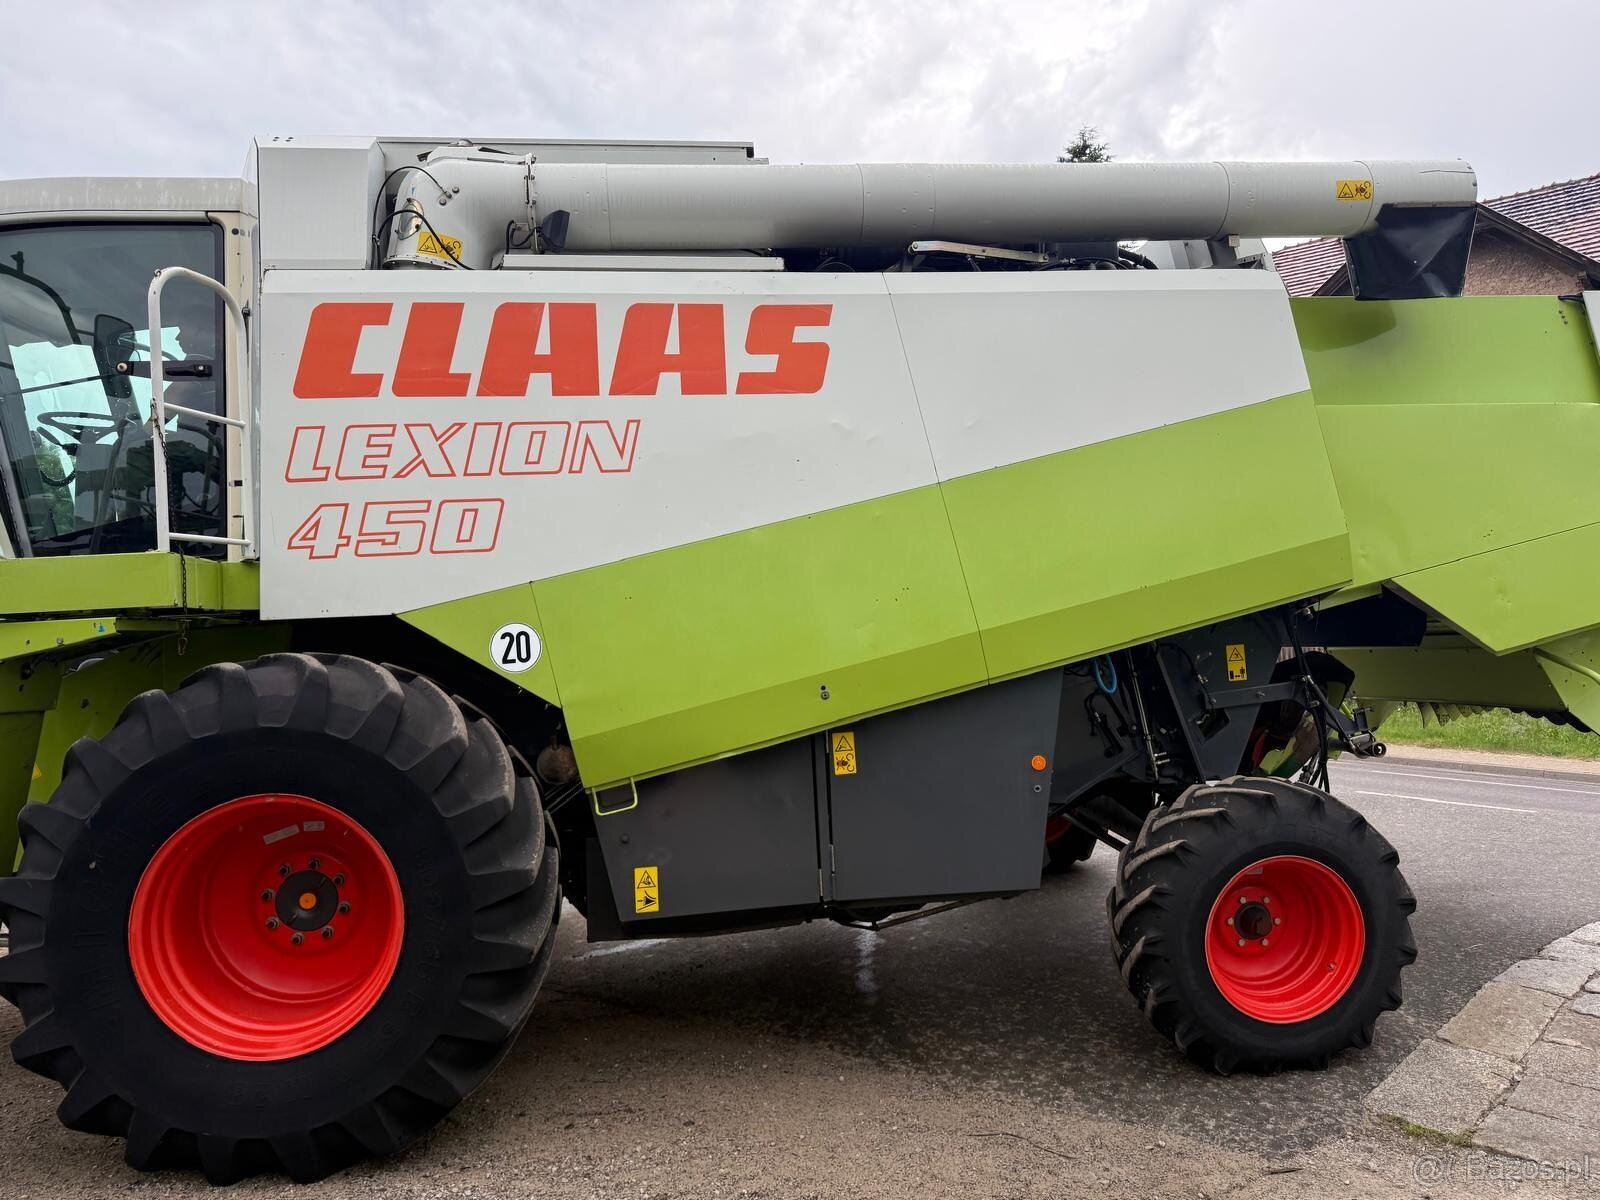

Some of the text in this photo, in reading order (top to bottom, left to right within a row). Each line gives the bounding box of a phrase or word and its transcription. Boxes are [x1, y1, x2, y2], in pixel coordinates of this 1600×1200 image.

[292, 302, 834, 399] CLAAS
[284, 419, 641, 483] LEXION
[287, 498, 505, 560] 450
[500, 630, 531, 665] 20
